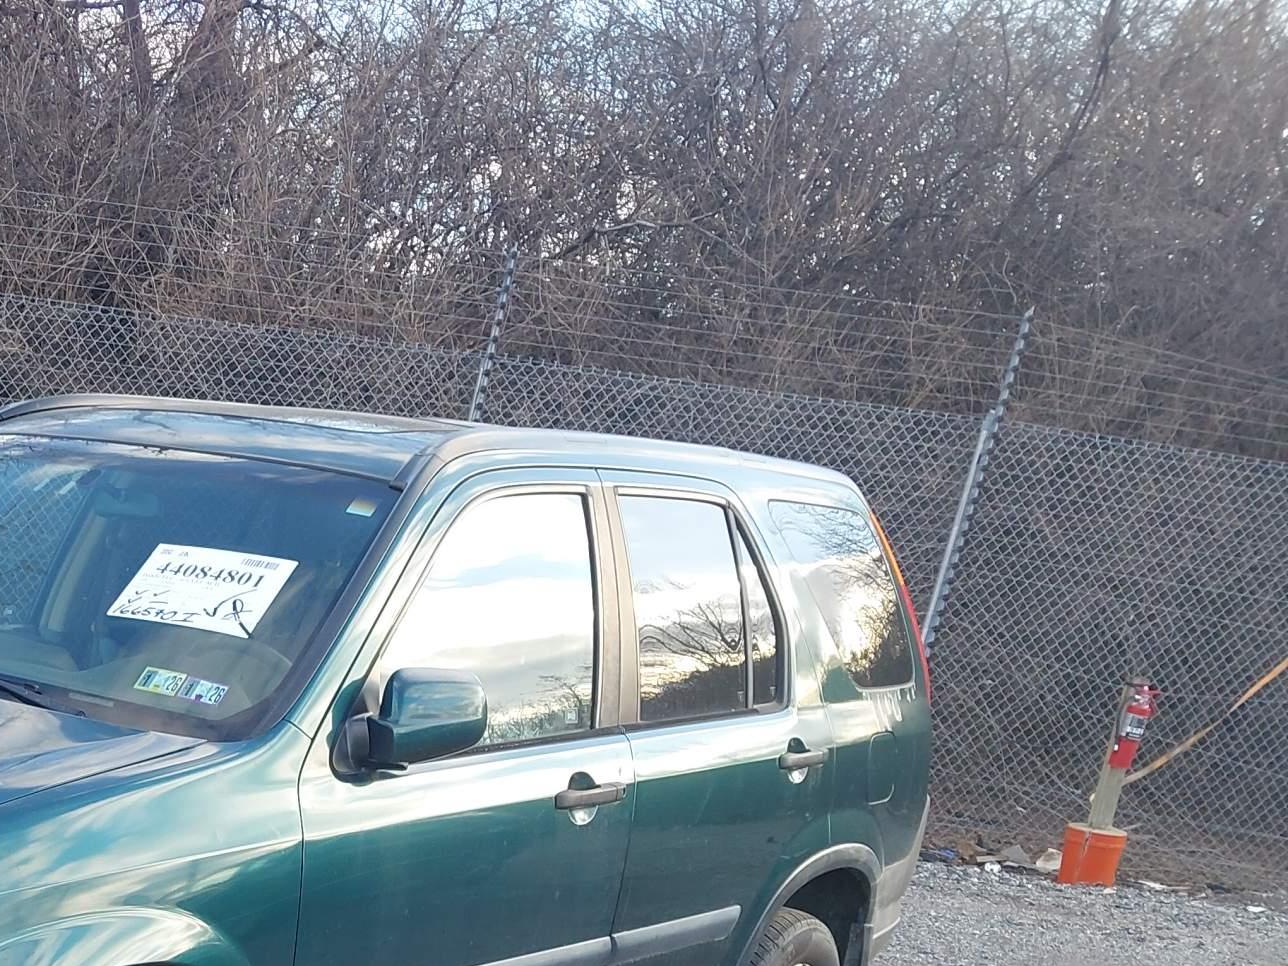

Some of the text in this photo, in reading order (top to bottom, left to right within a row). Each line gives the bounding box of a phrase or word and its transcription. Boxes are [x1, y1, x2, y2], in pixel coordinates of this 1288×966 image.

[156, 561, 265, 588] 44084801
[165, 675, 183, 692] 26
[208, 686, 226, 703] 26
